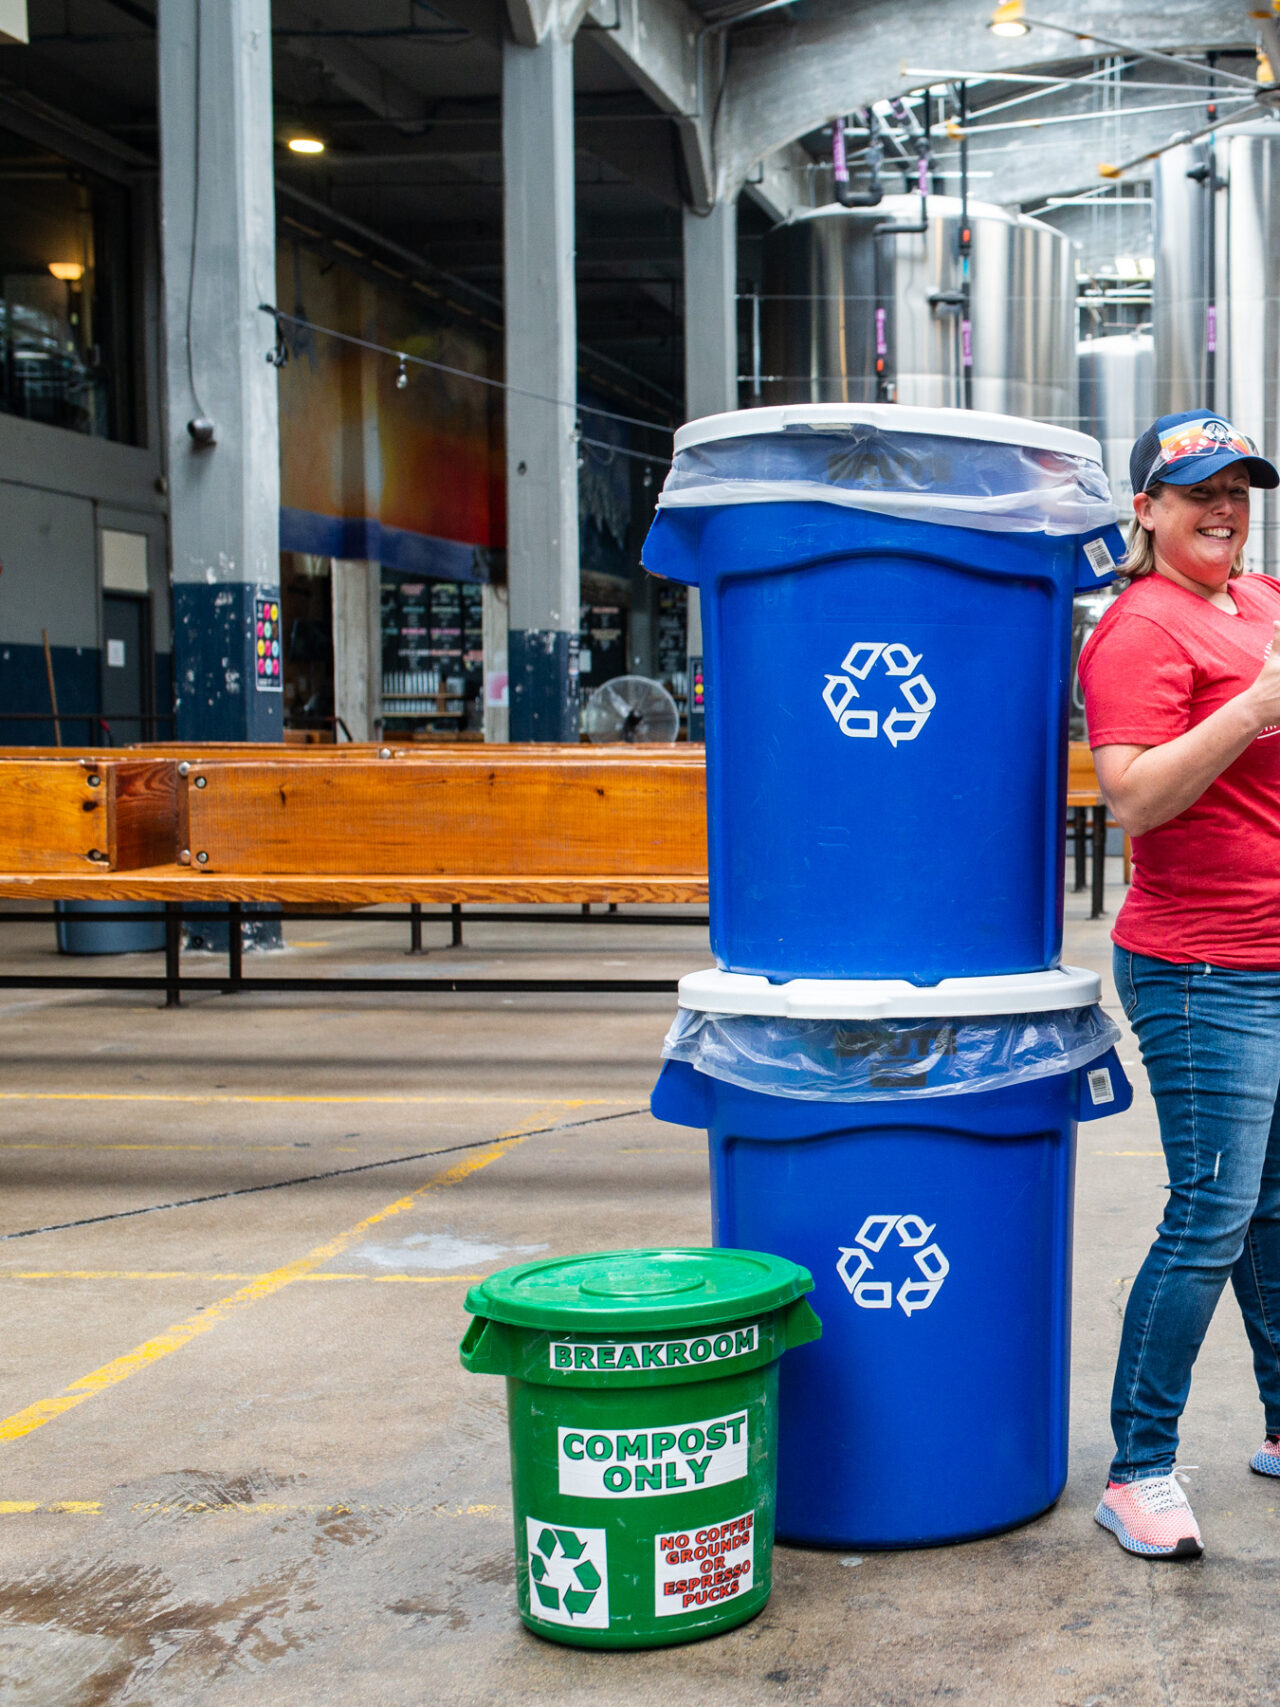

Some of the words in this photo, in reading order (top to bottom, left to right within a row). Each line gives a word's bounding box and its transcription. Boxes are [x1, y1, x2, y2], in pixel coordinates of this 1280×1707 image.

[554, 1327, 755, 1369] BREAKROOM
[562, 1415, 746, 1461] COMPOST
[603, 1455, 713, 1493] ONLY
[660, 1534, 690, 1551] NO
[695, 1514, 754, 1545] COFFEE
[666, 1532, 751, 1565] GROUNDS
[663, 1559, 752, 1596] ESPRESSO
[700, 1555, 726, 1574] OR
[682, 1582, 740, 1609] PUCKS
